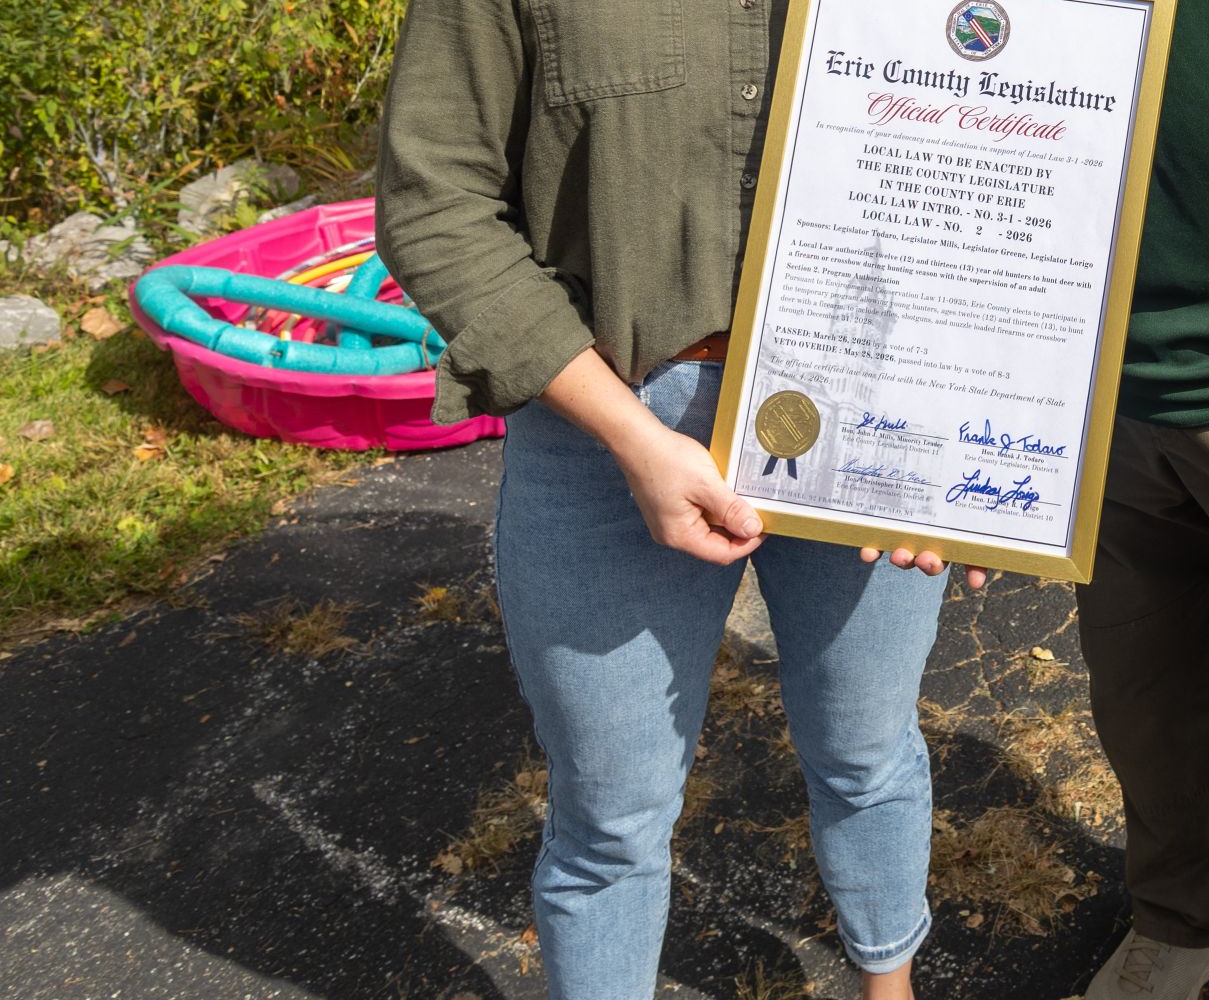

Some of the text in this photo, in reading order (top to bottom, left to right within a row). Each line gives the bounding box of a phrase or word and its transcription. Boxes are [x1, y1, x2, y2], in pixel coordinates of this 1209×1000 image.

[825, 49, 1116, 112] Erie County Legislature
[866, 91, 1066, 142] Official Certificate
[856, 158, 1054, 196] THE ERIE COUNTY LEGISLATURE
[863, 143, 1052, 179] LOCAL LAW TO BE ENACTED BY
[848, 190, 887, 205] LOCAL
[890, 196, 919, 209] LAW
[921, 200, 962, 216] INTRO.
[973, 208, 993, 220] NO.
[996, 212, 1013, 223] 3-1
[1024, 215, 1052, 229] 2026
[879, 178, 1025, 208] IN THE COUNTY OF ERIE
[796, 218, 1093, 269] Sponsors: Legislator Todaro, Legislator Mills, Legislator Greene, Legislator Lorigo
[861, 208, 900, 224] LOCAL
[903, 215, 933, 228] LAW
[942, 220, 962, 232] NO.
[975, 225, 982, 235] 2
[1005, 229, 1032, 243] 2026
